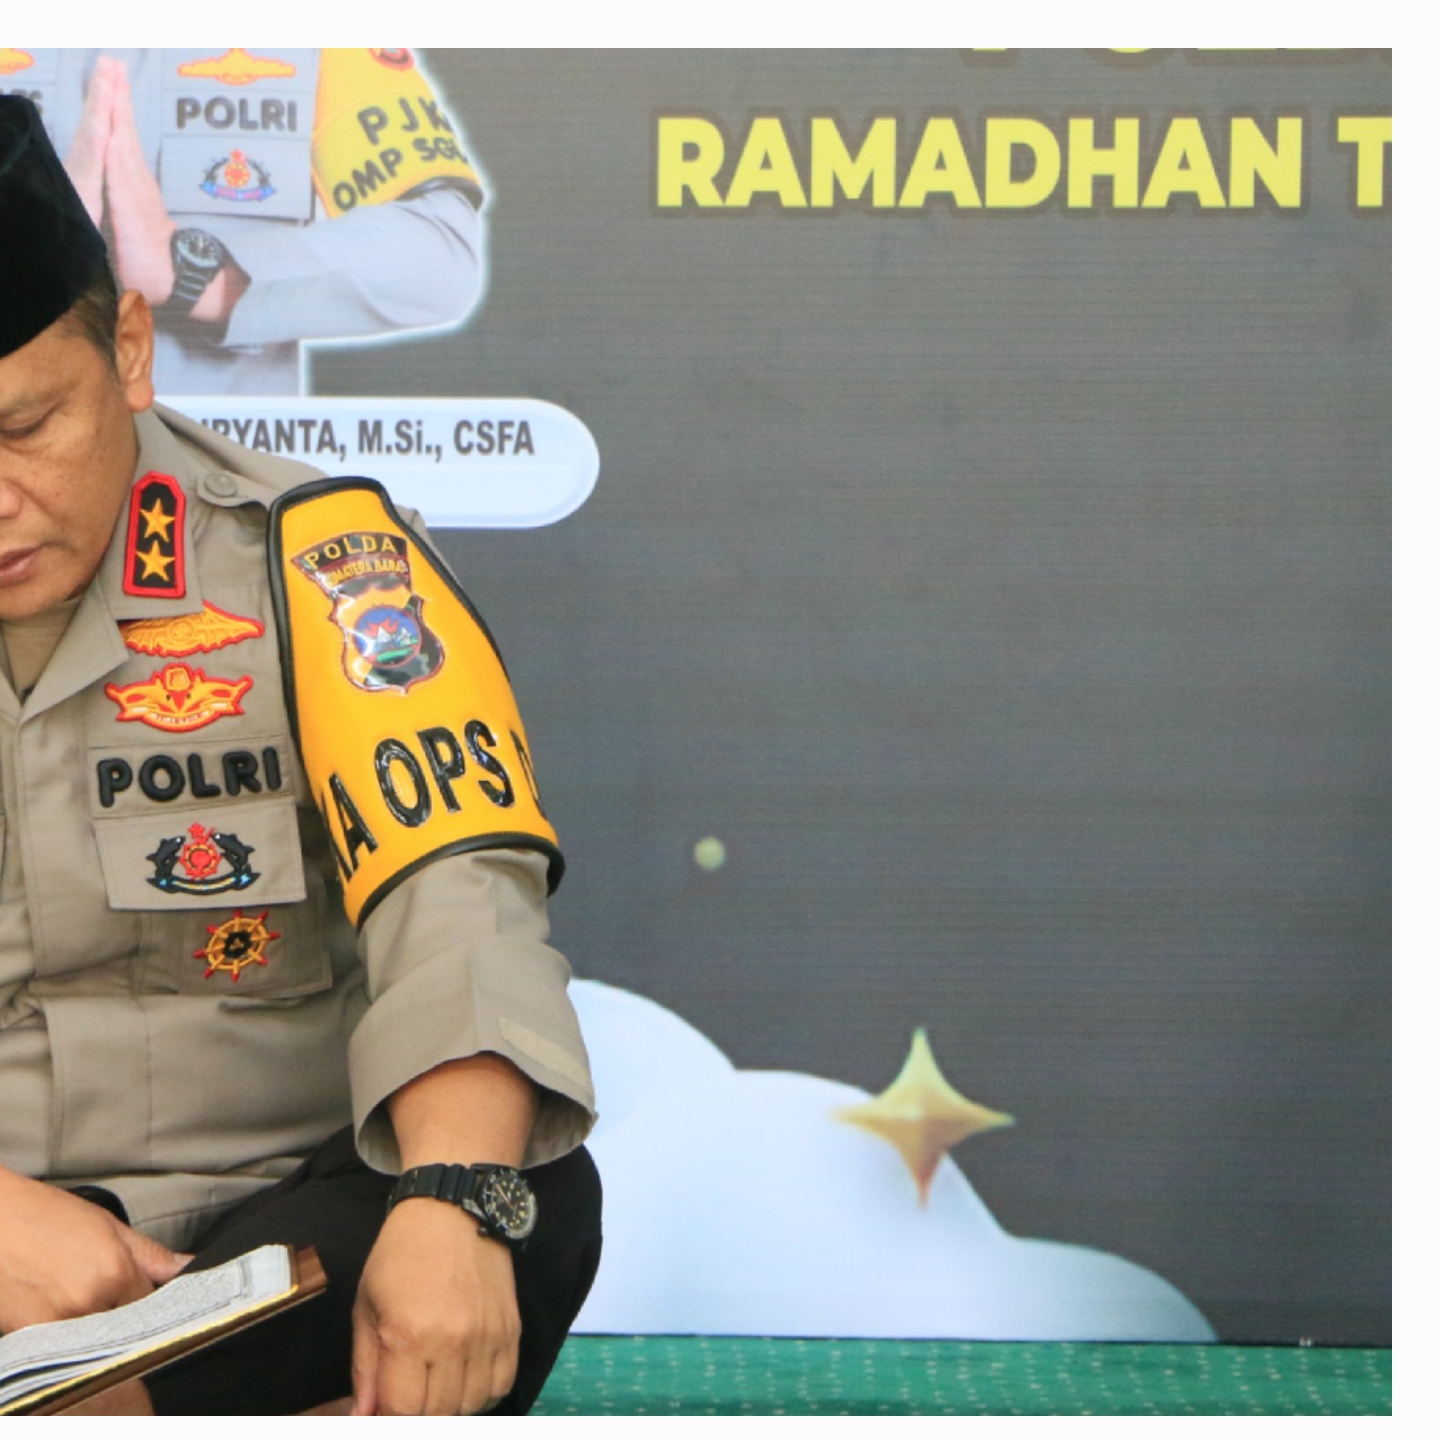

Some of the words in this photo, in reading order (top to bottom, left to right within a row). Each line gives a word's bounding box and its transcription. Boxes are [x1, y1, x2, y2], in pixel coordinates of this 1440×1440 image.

[176, 97, 298, 132] POLRI
[333, 148, 403, 212] OMP
[657, 117, 1303, 208] RAMADHAN
[358, 420, 443, 462] M.Si.,
[453, 420, 535, 455] CSFA
[303, 535, 398, 570] POLDA
[97, 746, 282, 808] POLRI
[375, 719, 515, 828] OPS
